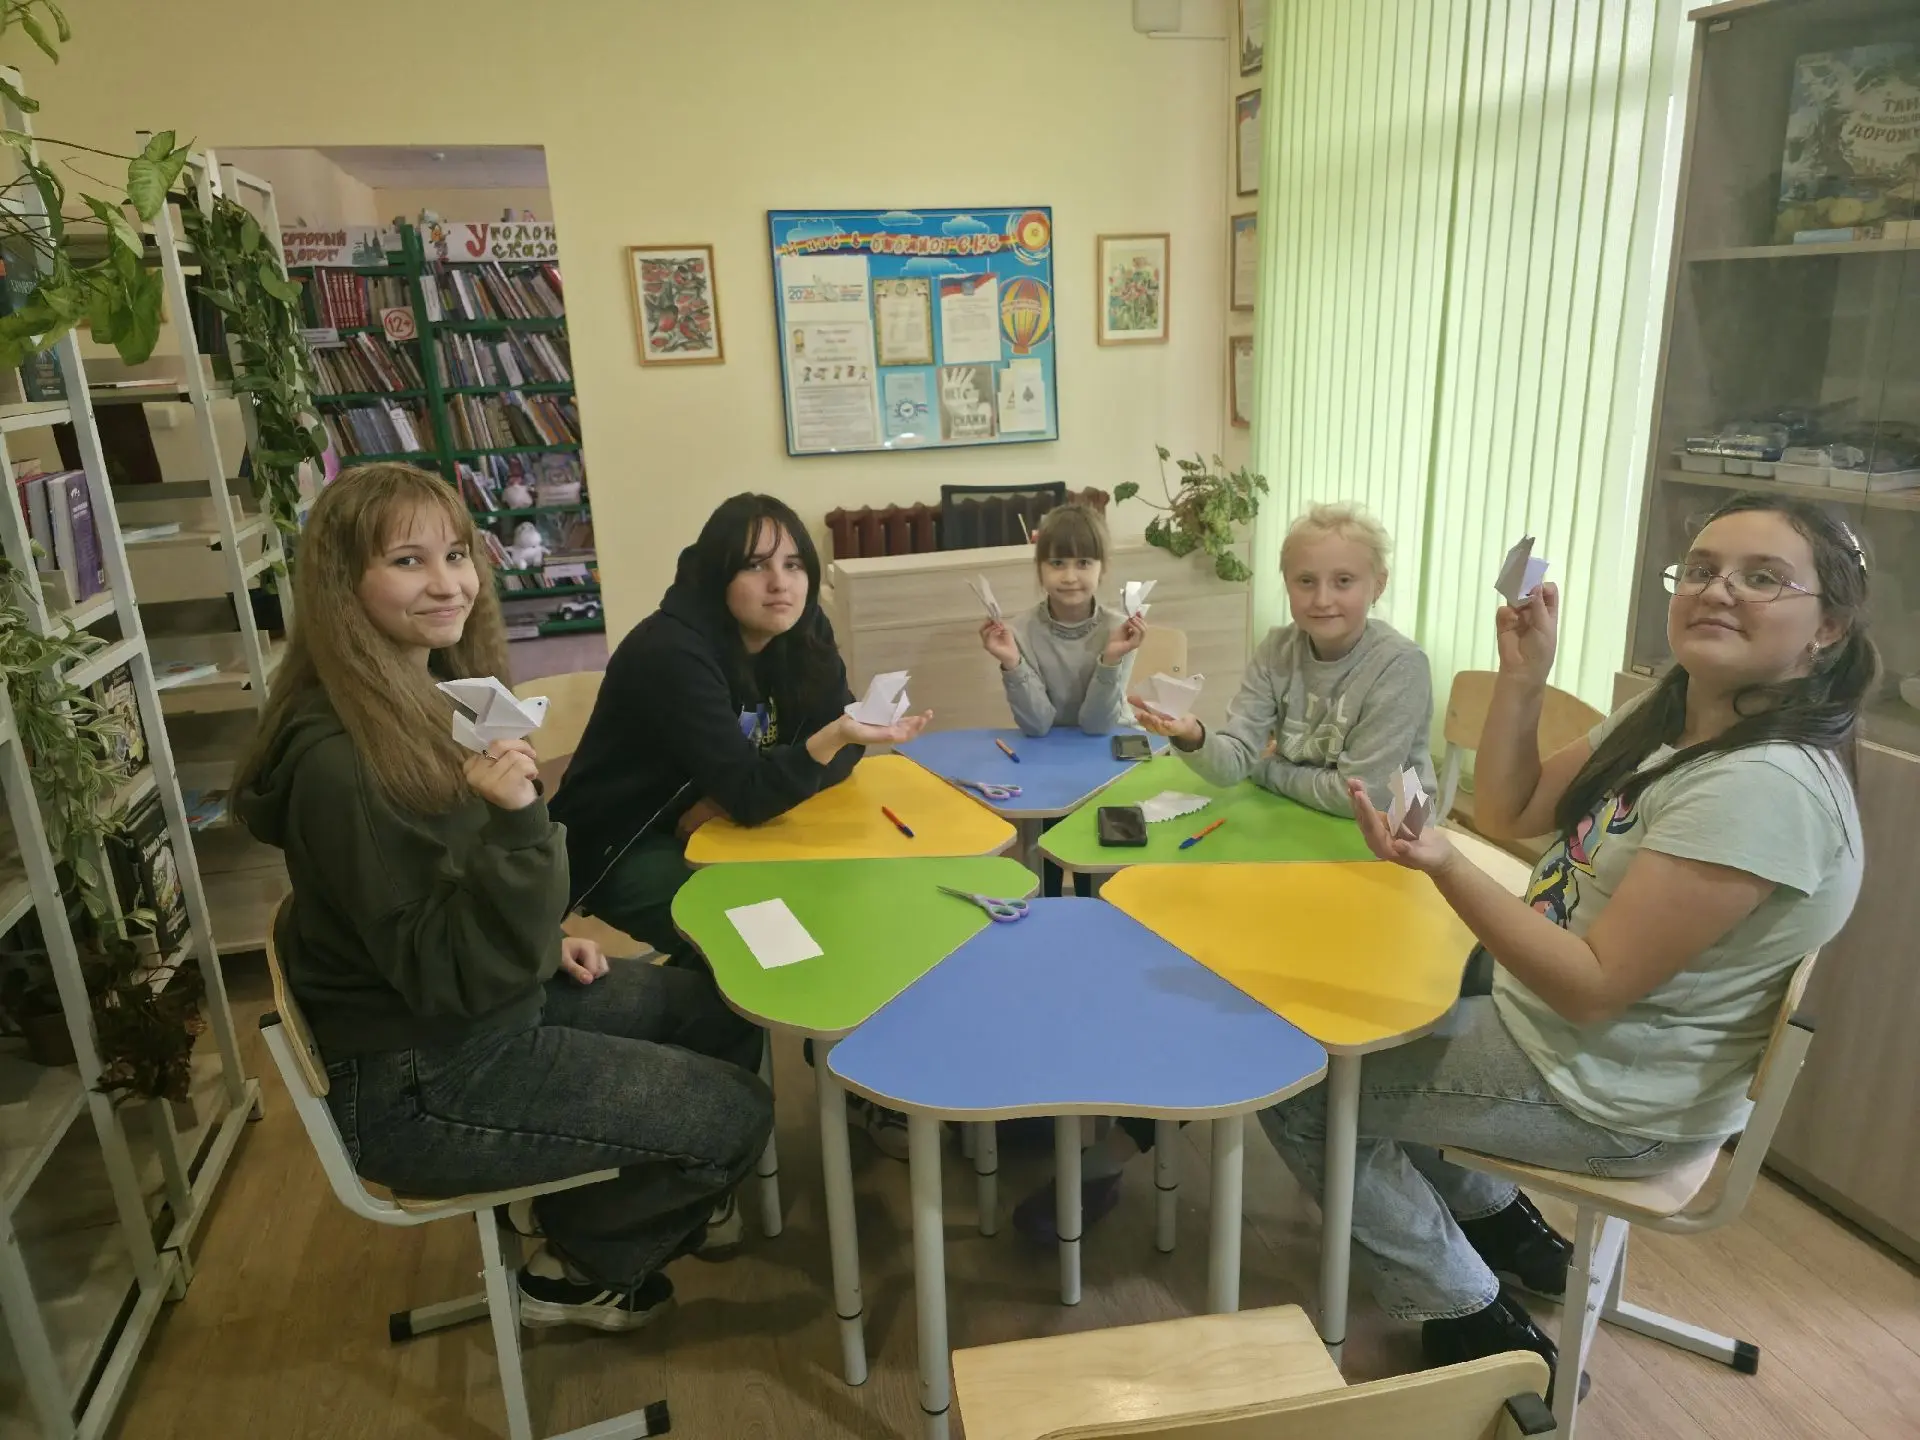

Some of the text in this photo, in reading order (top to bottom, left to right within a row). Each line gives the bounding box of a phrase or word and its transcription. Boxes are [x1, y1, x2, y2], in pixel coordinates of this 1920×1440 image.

[282, 228, 347, 246] ОТОРЫЙ
[492, 242, 557, 258] сказо
[387, 316, 412, 333] 12+
